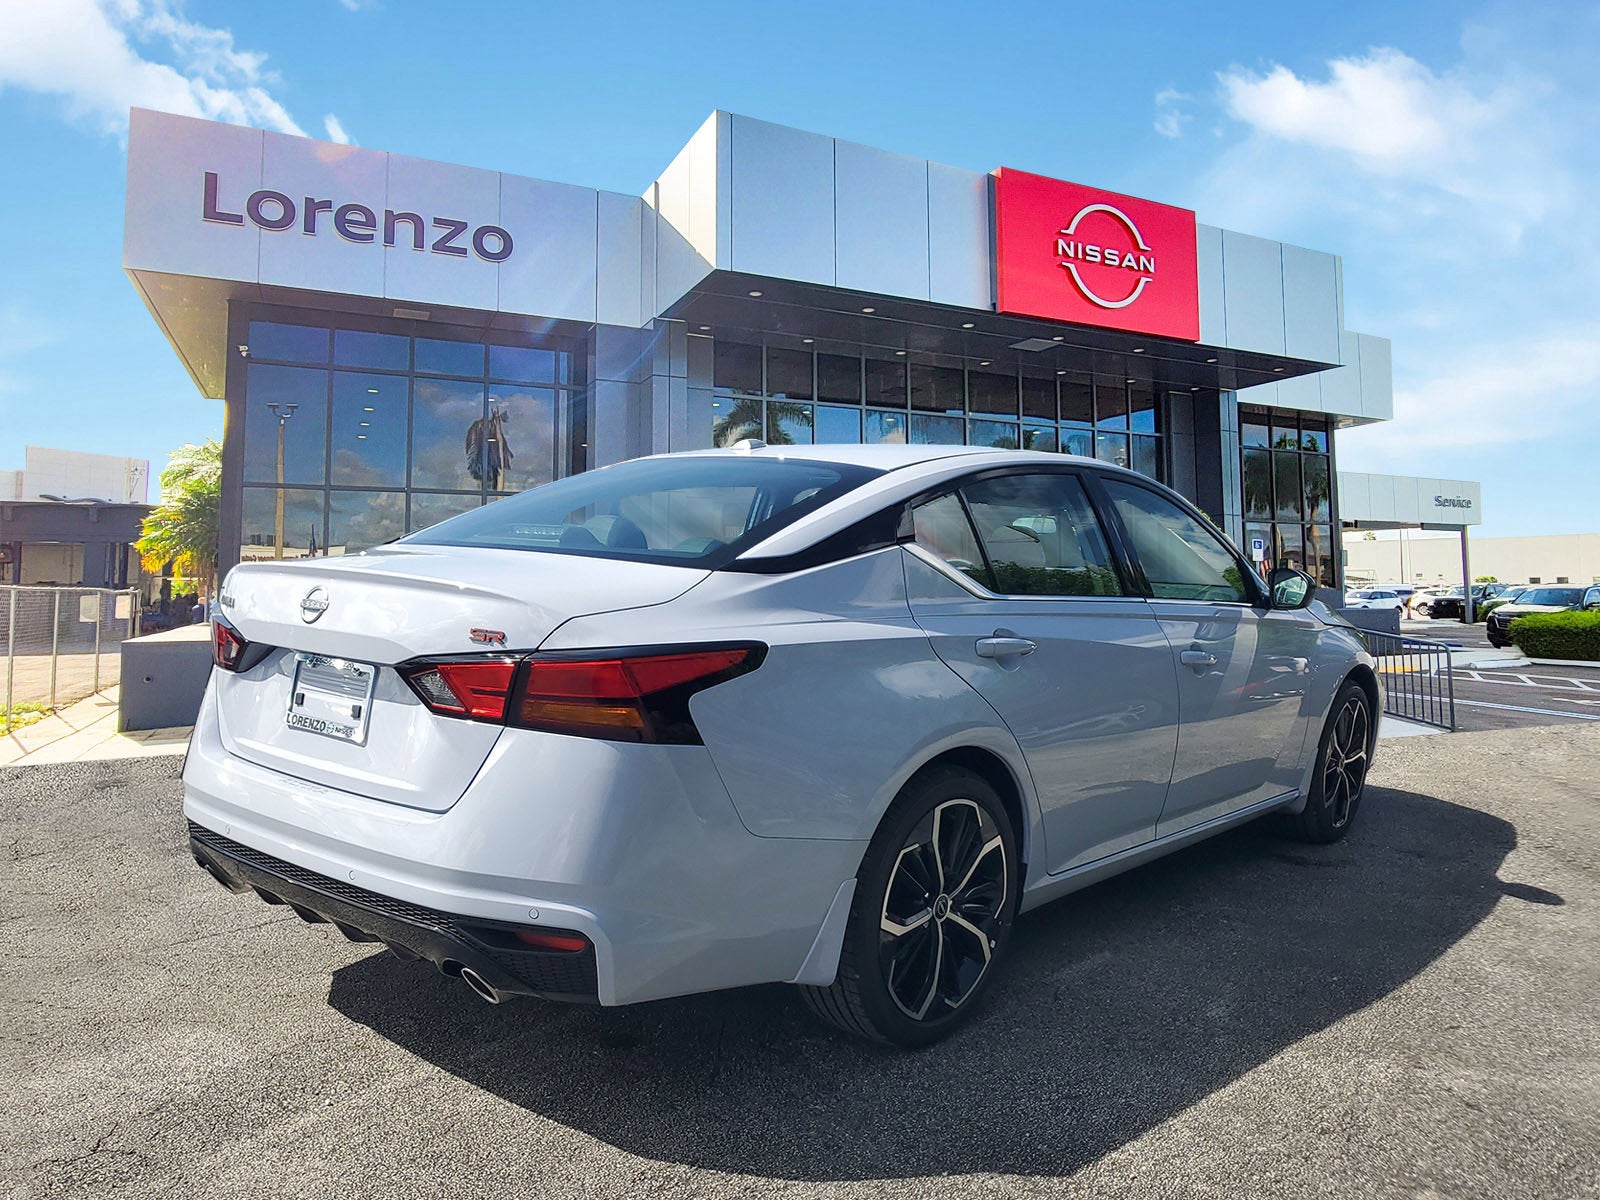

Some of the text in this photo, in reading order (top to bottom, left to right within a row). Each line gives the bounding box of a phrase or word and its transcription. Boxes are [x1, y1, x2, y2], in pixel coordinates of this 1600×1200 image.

[202, 171, 514, 263] Lorenzo
[1057, 238, 1155, 273] NISSAN
[1434, 495, 1472, 508] Service
[469, 628, 507, 648] SR
[286, 712, 327, 732] LORENZO
